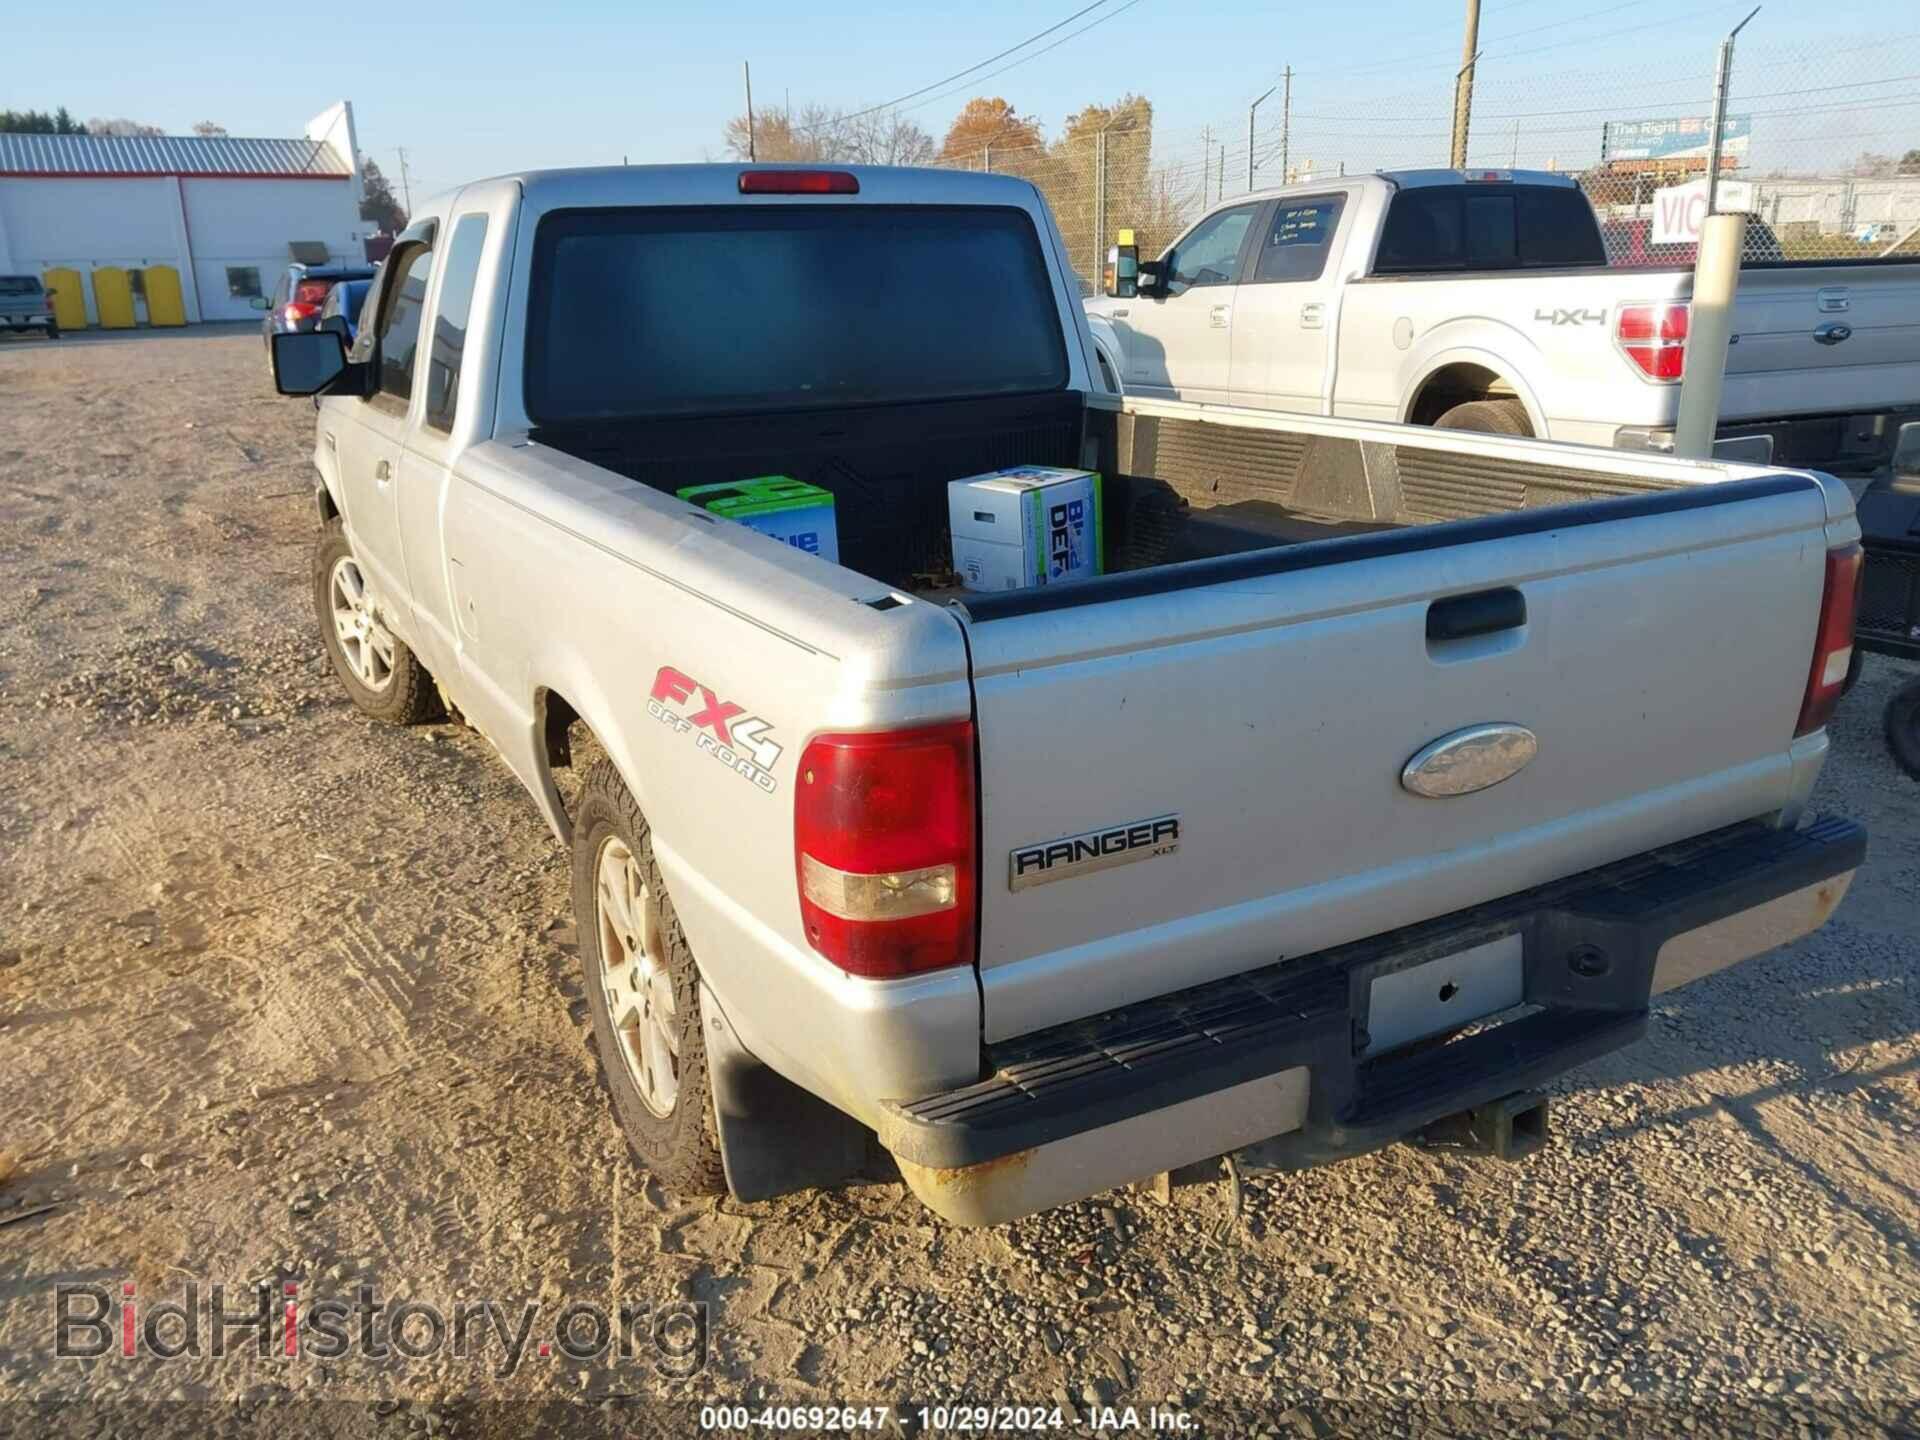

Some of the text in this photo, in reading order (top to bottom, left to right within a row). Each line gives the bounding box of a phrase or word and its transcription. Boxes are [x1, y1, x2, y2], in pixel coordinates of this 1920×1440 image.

[1641, 120, 1677, 136] Right
[647, 698, 777, 794] OFF ROAD
[650, 665, 784, 772] FX4
[1016, 818, 1179, 876] RANGER
[1152, 845, 1177, 857] XLT
